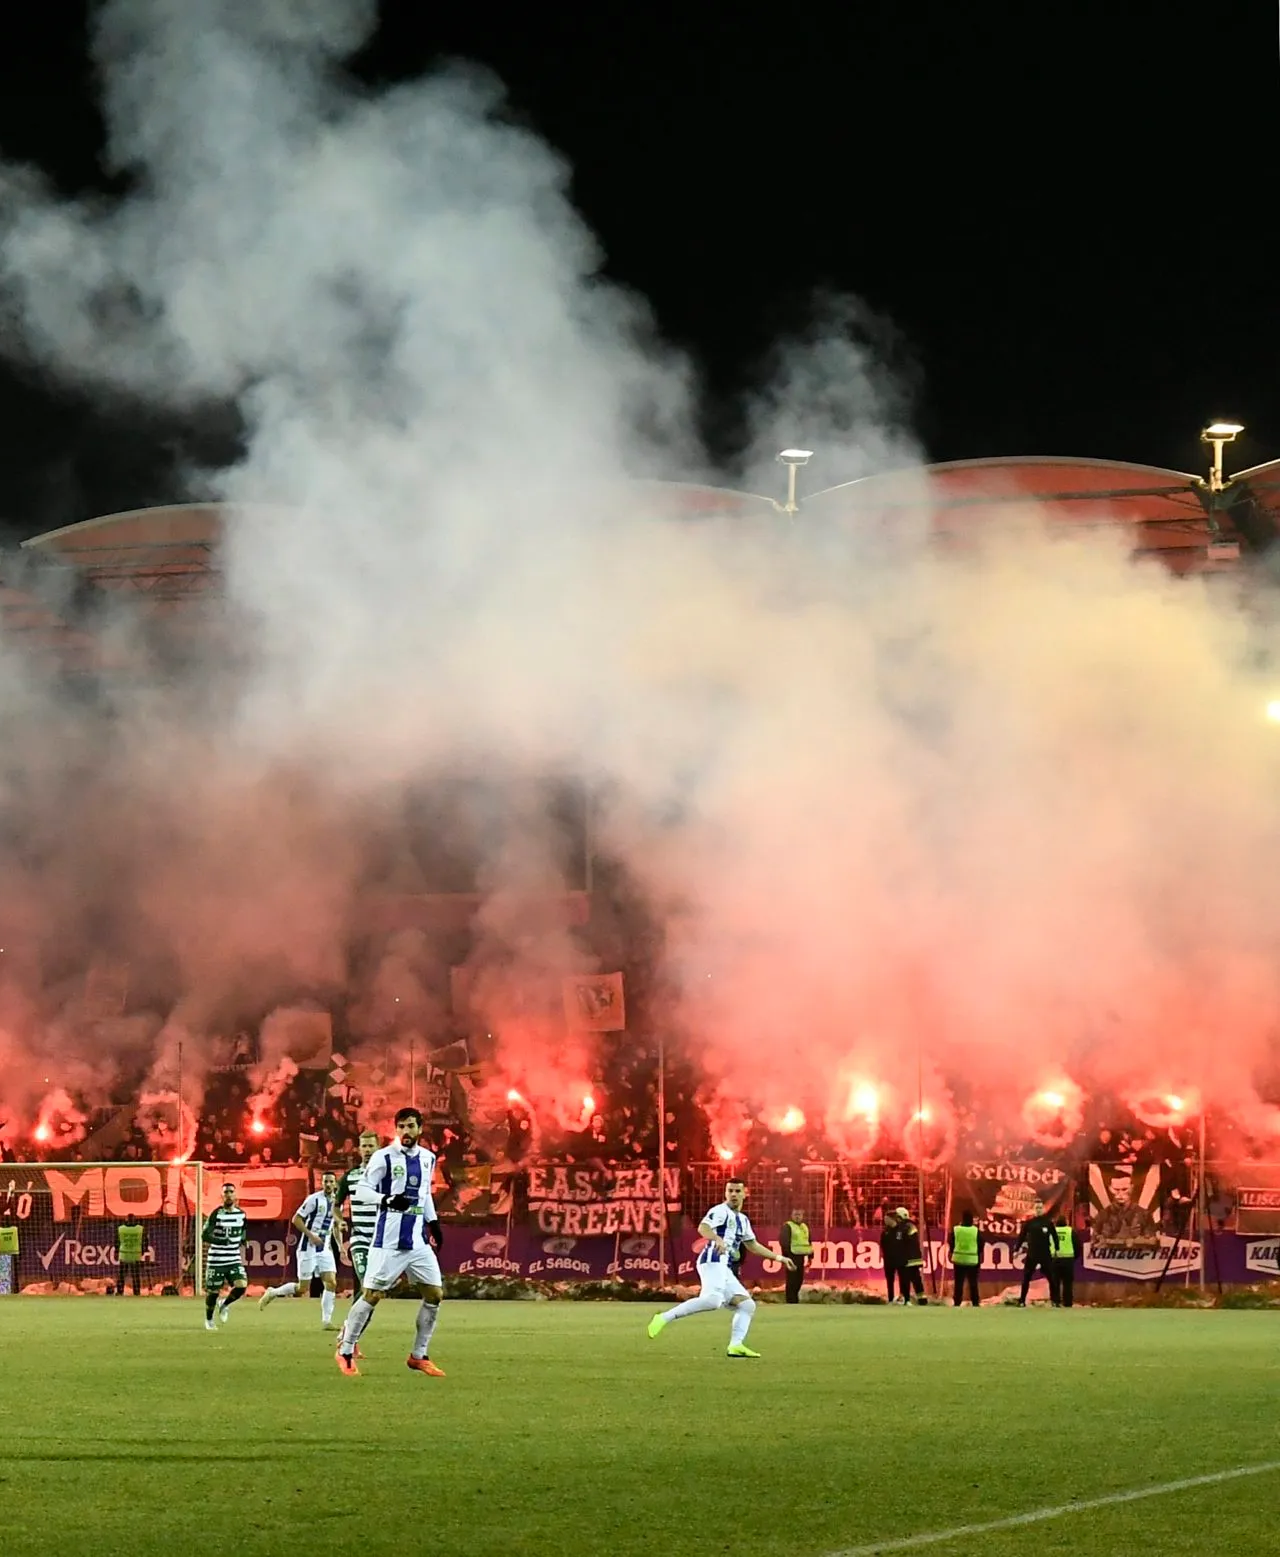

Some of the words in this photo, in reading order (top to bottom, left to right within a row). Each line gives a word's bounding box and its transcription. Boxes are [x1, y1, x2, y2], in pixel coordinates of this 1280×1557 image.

[527, 1167, 681, 1200] EASERN
[537, 1202, 668, 1236] GREENS
[64, 1240, 156, 1266] Rexoa
[458, 1261, 474, 1274] EL
[477, 1257, 521, 1274] SABOR
[528, 1261, 545, 1274] EL
[546, 1257, 591, 1274] SABOR
[606, 1259, 623, 1274] EL
[624, 1258, 670, 1274] SABOR
[678, 1262, 695, 1274] EL
